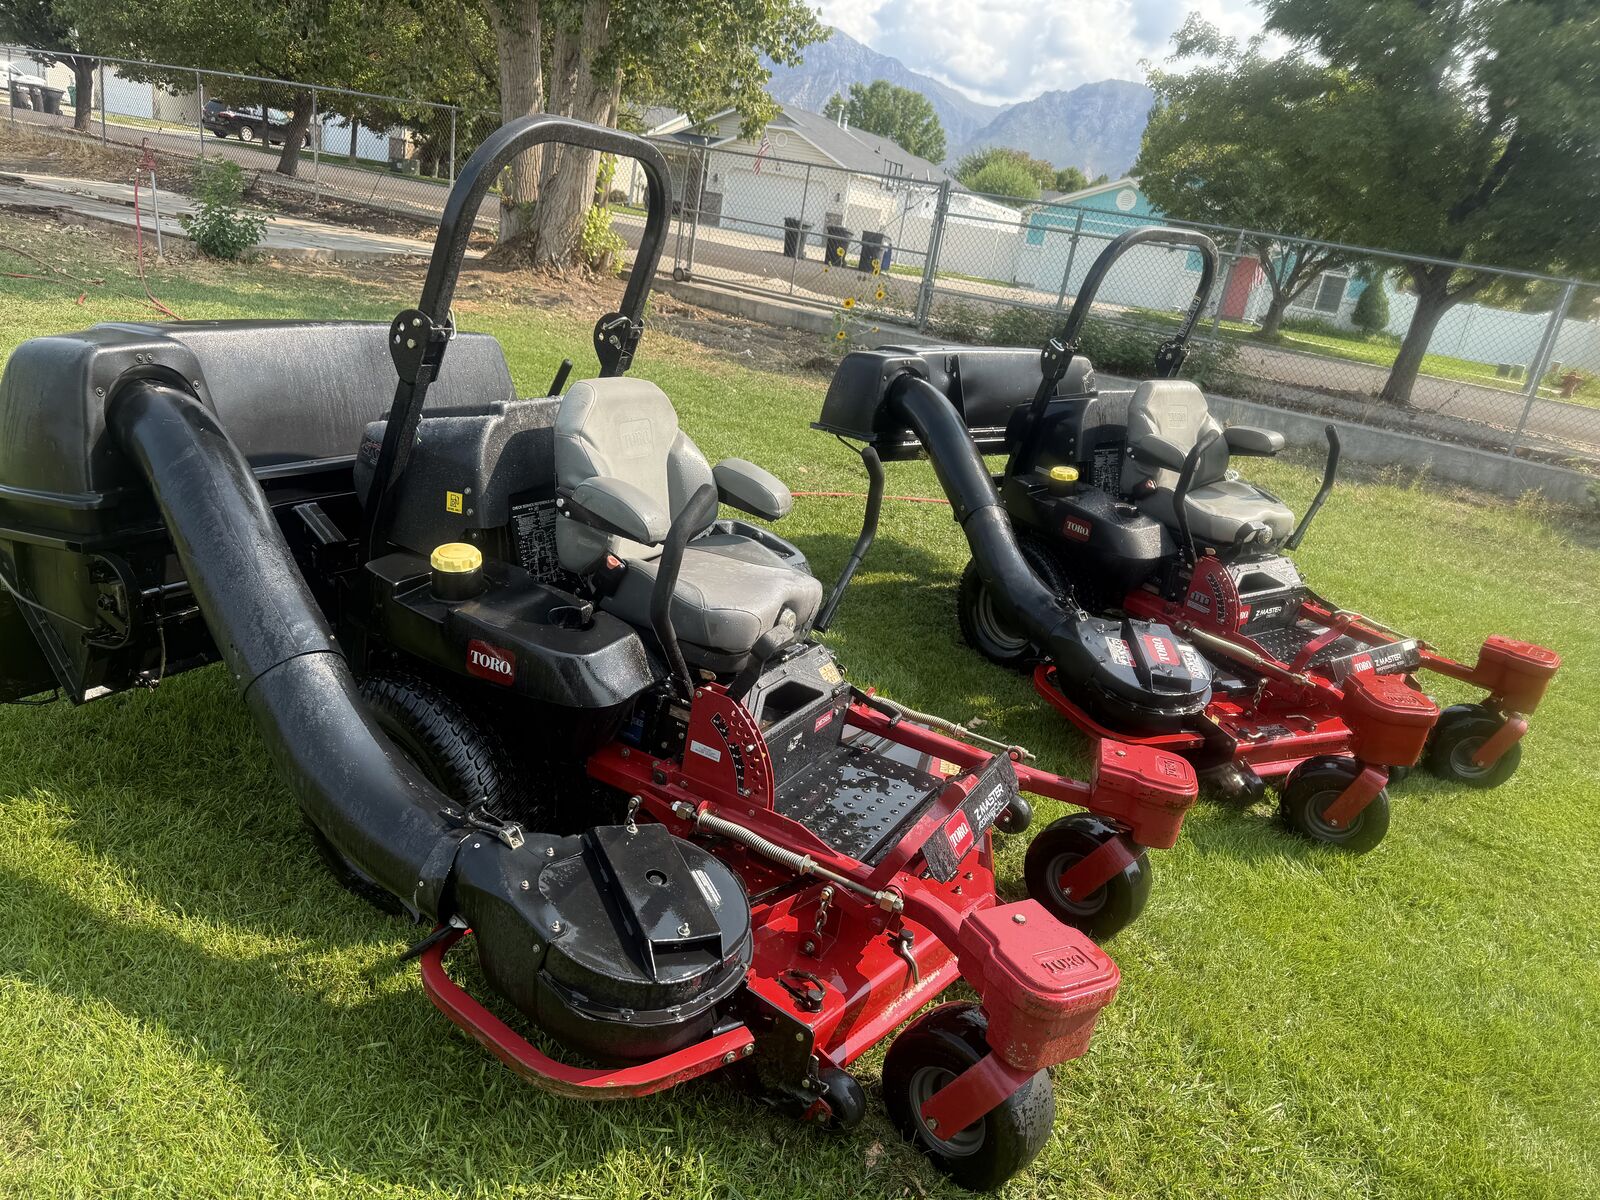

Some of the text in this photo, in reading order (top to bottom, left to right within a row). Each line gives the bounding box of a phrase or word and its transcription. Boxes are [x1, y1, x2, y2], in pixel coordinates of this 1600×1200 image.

[1066, 520, 1090, 536] TORO
[1152, 637, 1170, 664] TORO
[1380, 653, 1402, 666] MASTER
[470, 650, 513, 676] TORO
[1355, 660, 1373, 673] TORO
[979, 783, 1005, 817] MASTER
[950, 822, 969, 848] TORO
[1040, 954, 1085, 974] TORO
